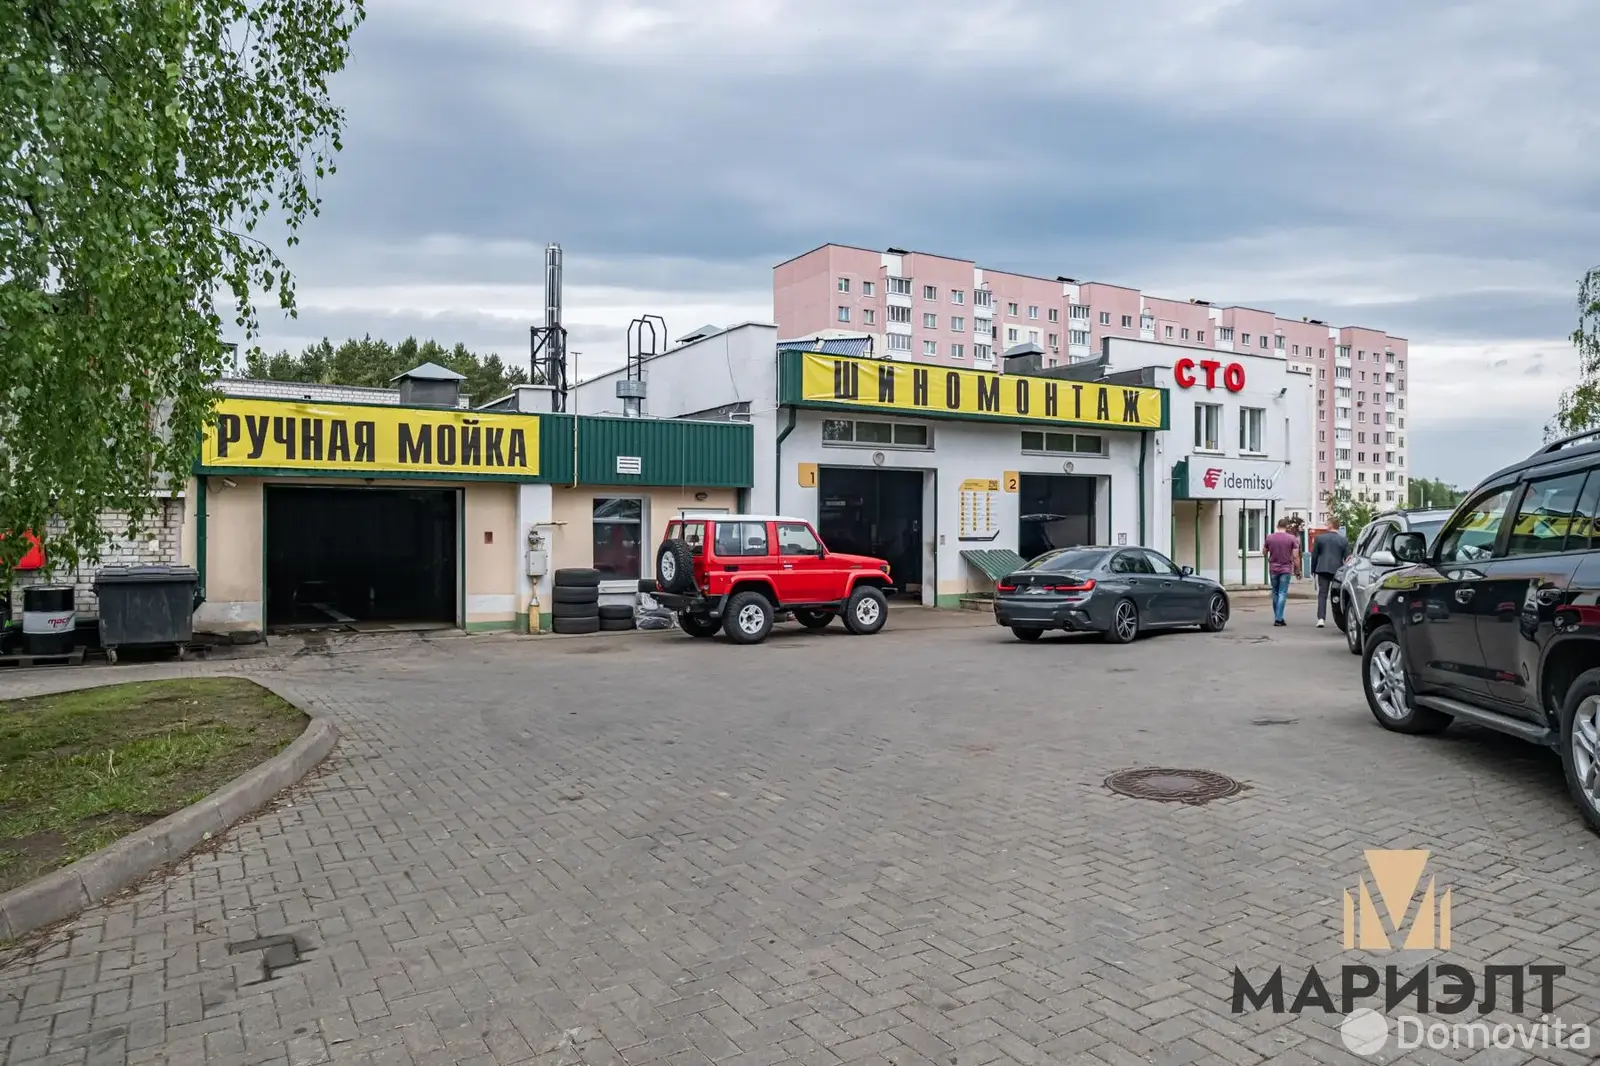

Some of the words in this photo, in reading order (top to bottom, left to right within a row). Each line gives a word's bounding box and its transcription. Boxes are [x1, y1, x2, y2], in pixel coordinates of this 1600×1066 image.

[1174, 357, 1246, 393] СТО
[834, 360, 1141, 423] ШИНОМОНТАЖ
[217, 413, 376, 463] РУЧНАЯ
[397, 418, 528, 468] МОЙКА
[809, 471, 815, 485] 1
[1009, 478, 1017, 490] 2
[1223, 471, 1273, 490] idemitsu
